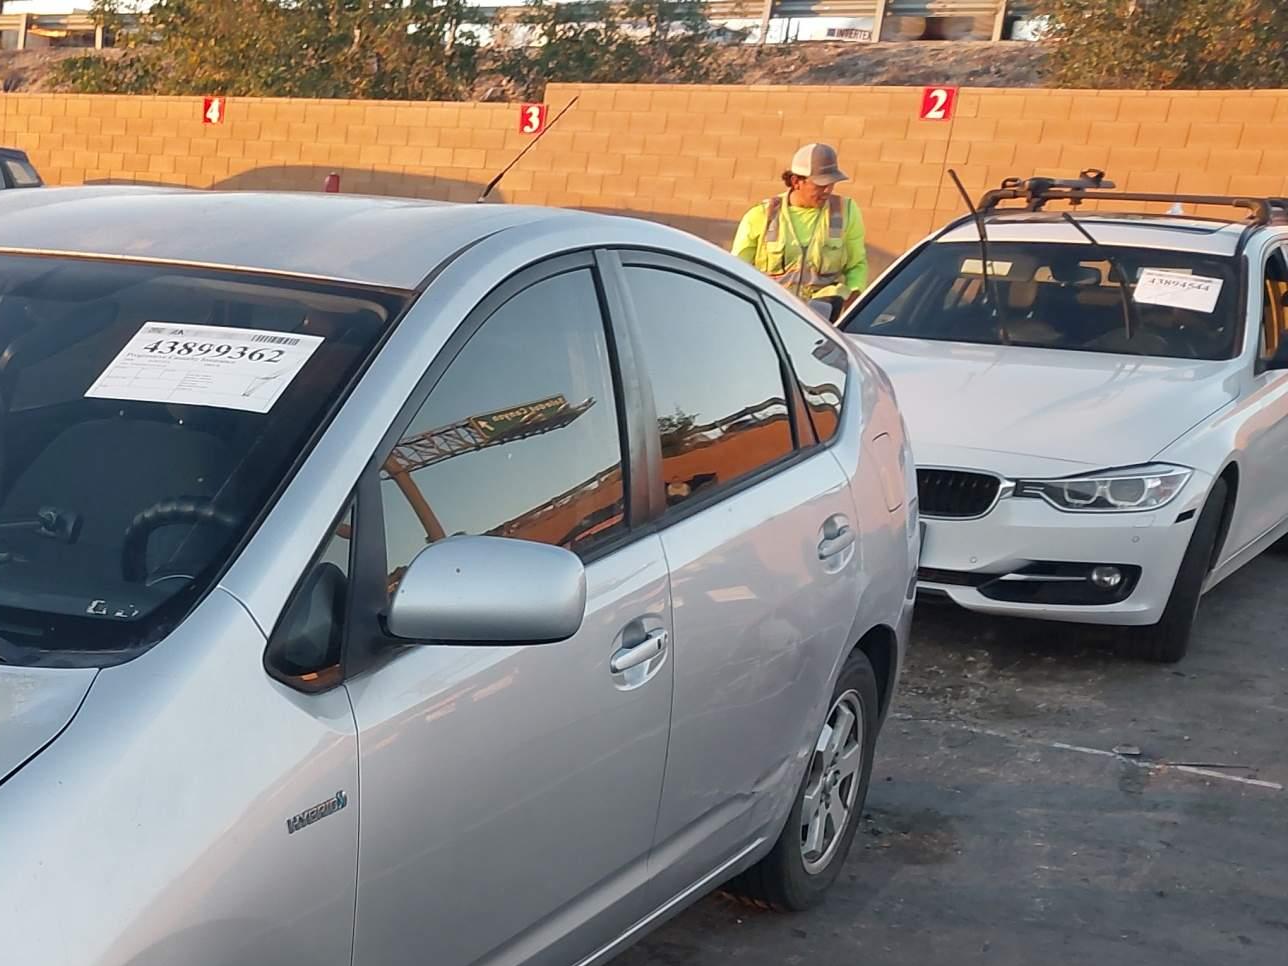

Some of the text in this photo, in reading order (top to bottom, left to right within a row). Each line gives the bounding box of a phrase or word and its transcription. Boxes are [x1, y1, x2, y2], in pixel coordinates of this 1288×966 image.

[206, 97, 220, 124] 4
[924, 89, 948, 119] 2
[523, 106, 540, 133] 3
[143, 339, 285, 364] 43899362
